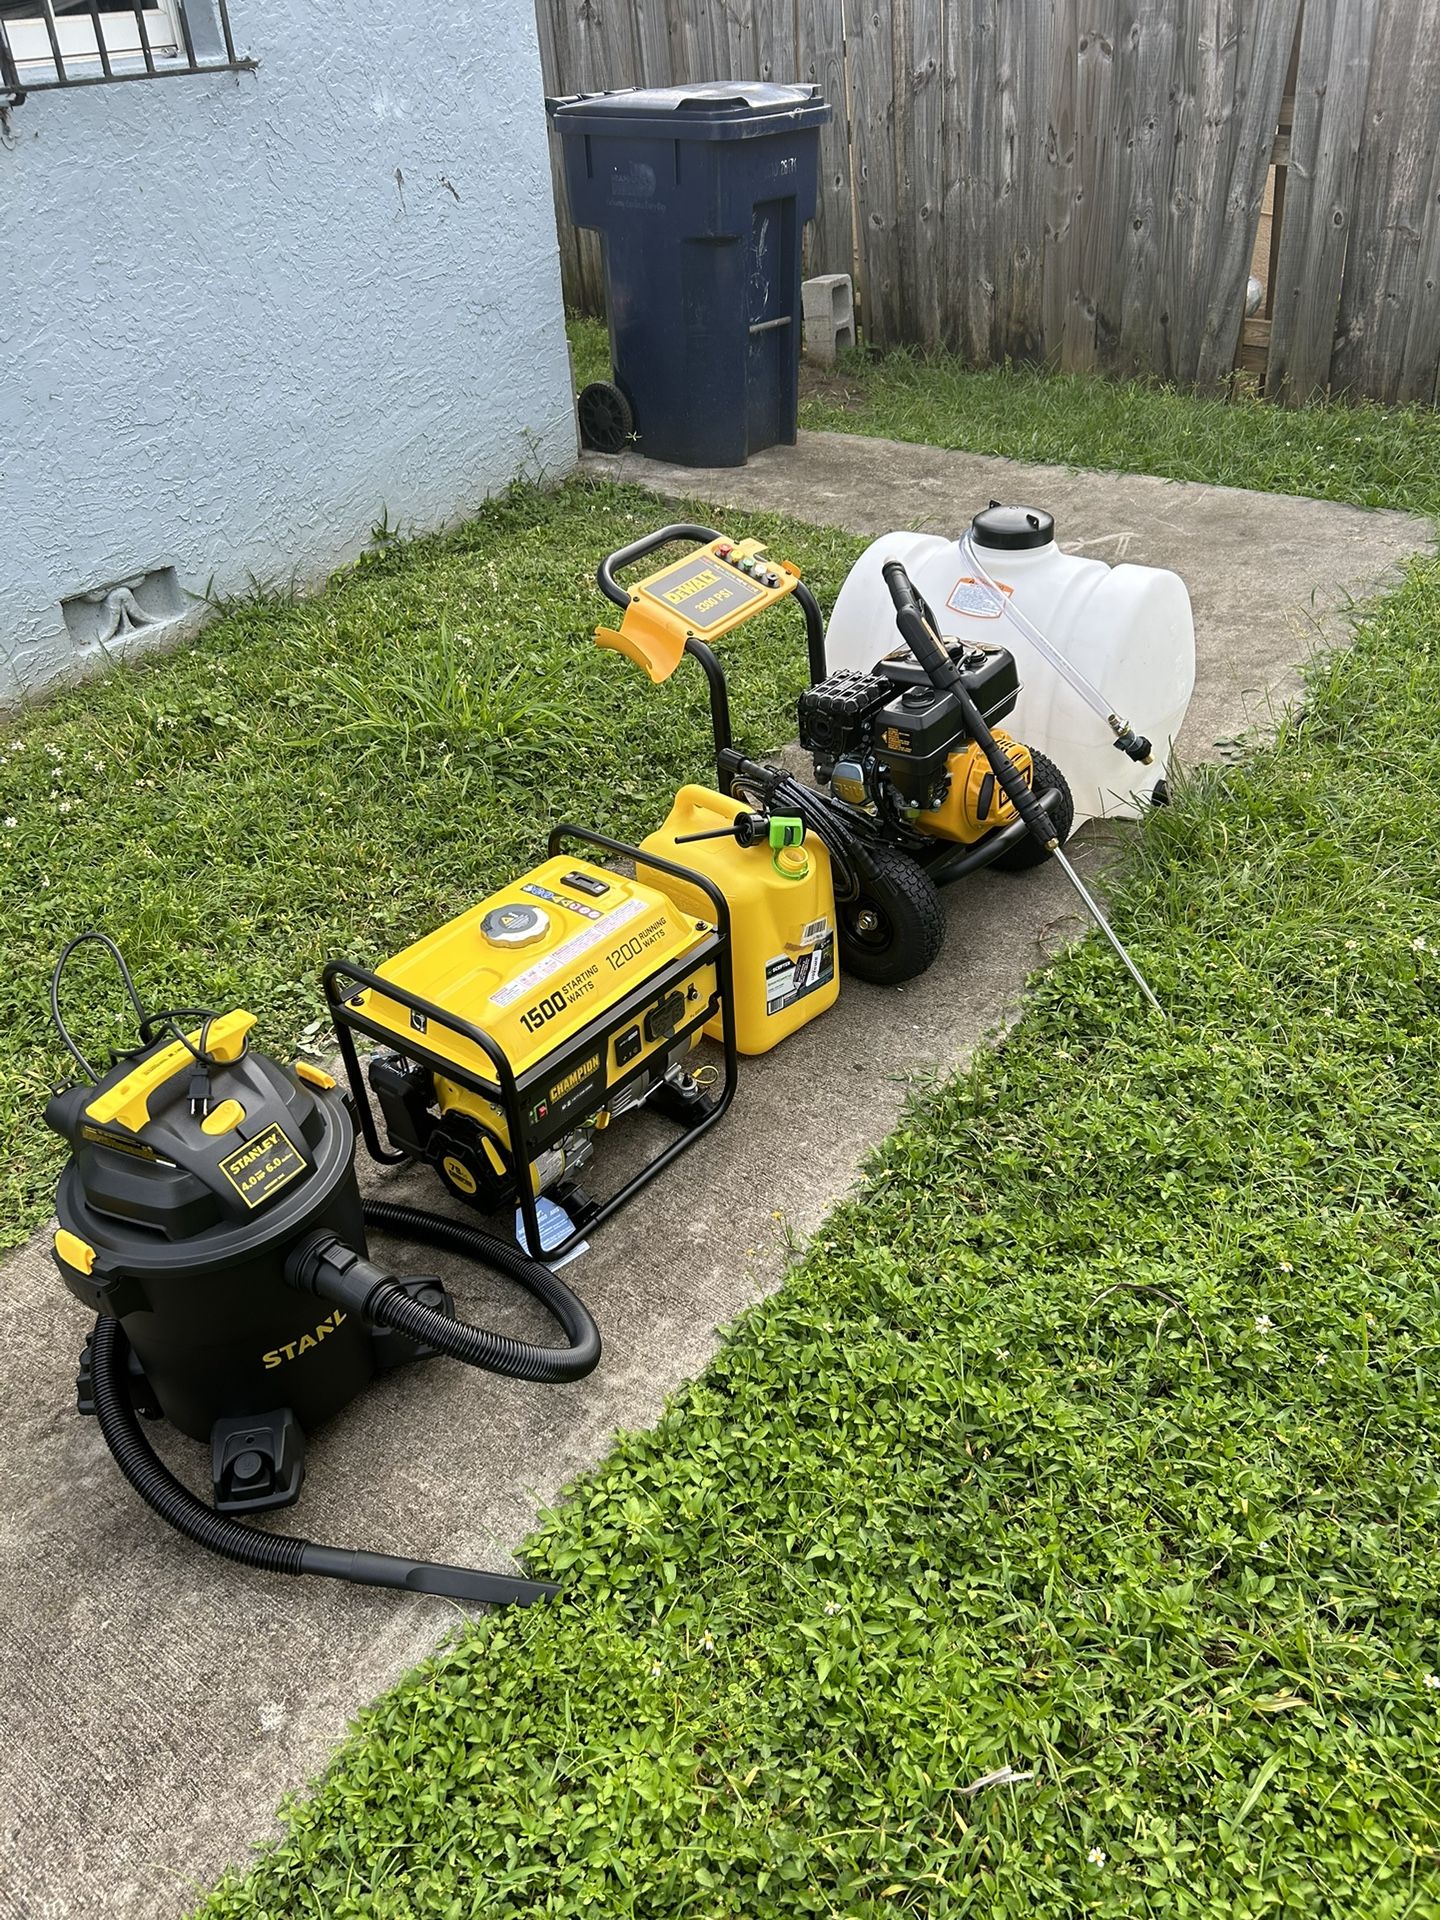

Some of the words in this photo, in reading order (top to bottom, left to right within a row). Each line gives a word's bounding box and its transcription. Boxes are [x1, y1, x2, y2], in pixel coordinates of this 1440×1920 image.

[665, 570, 720, 602] DEWALT
[716, 589, 734, 605] PSI
[639, 917, 667, 940] RUNNING
[642, 929, 666, 948] WATTS
[605, 937, 643, 971] 1200
[561, 964, 599, 995] STARTING
[566, 981, 595, 1004] WATTS
[519, 990, 568, 1033] 1500
[550, 1053, 600, 1103] CHAMPION
[229, 1133, 278, 1175] STANLEY
[241, 1176, 258, 1192] 4.0
[265, 1157, 282, 1173] 6.0
[262, 1309, 347, 1369] STANL
